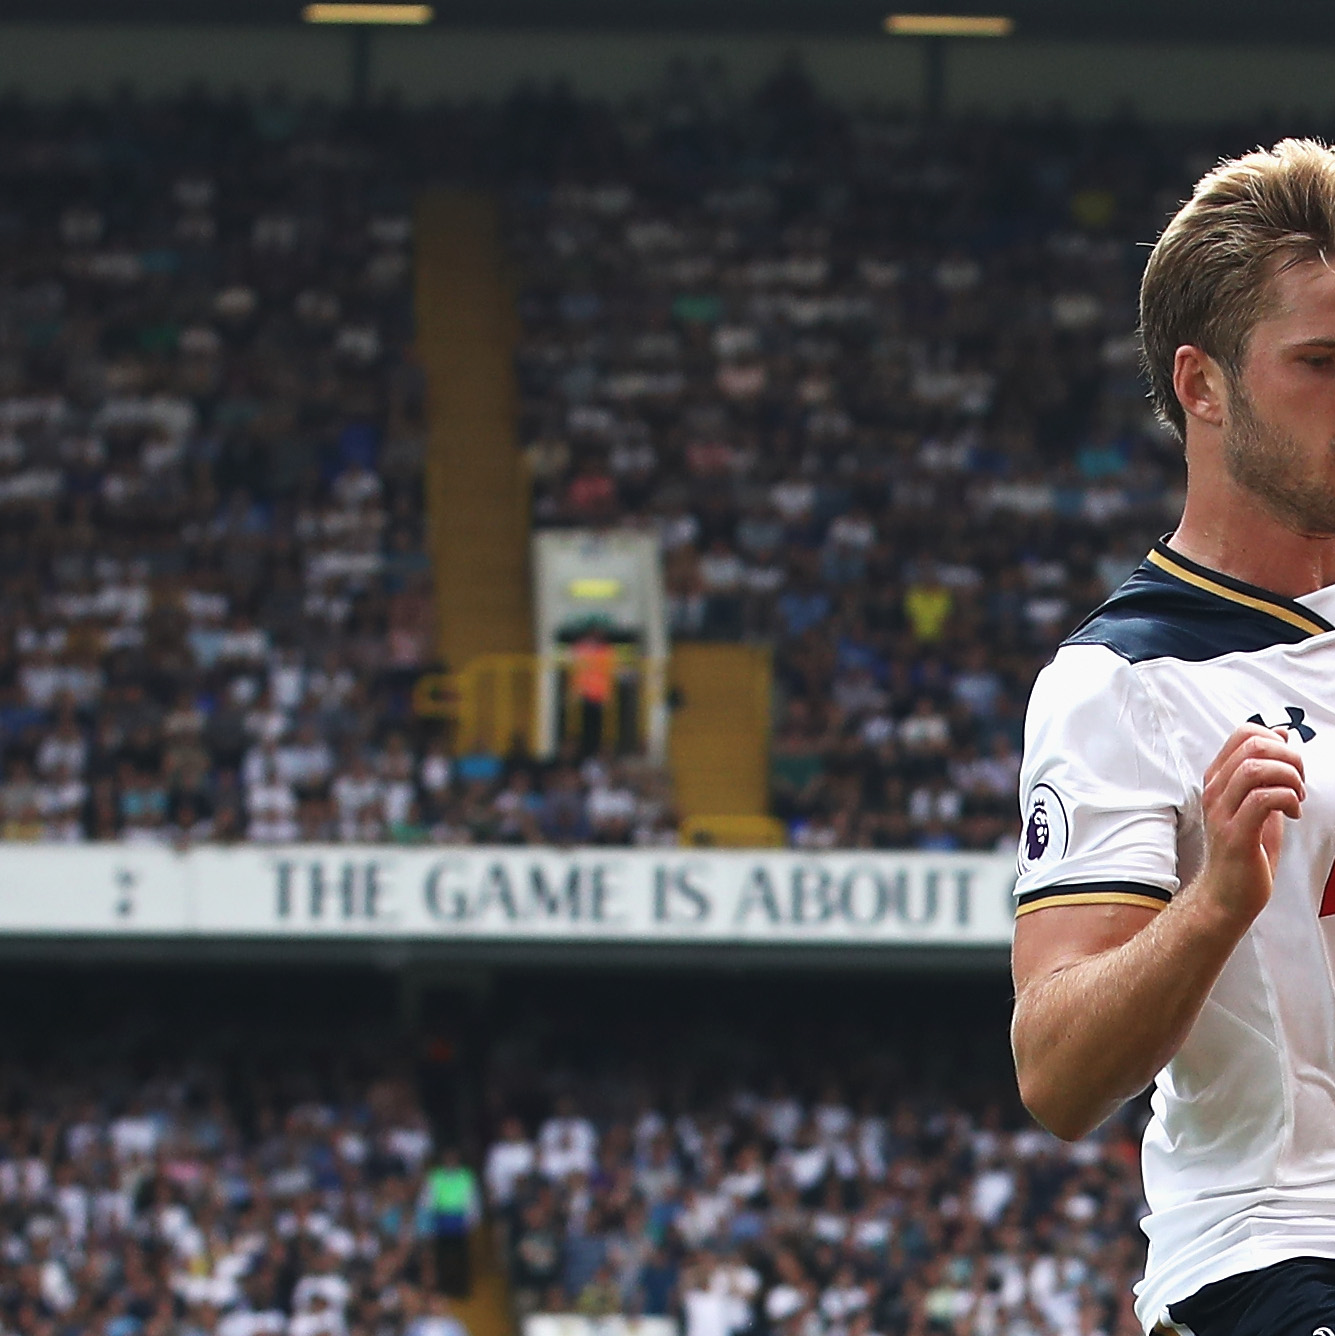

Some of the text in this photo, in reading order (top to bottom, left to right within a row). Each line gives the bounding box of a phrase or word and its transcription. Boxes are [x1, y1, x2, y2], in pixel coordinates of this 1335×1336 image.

[268, 860, 392, 920] THE
[422, 861, 628, 922] GAME
[652, 866, 712, 924] IS
[733, 867, 984, 926] ABOUT
